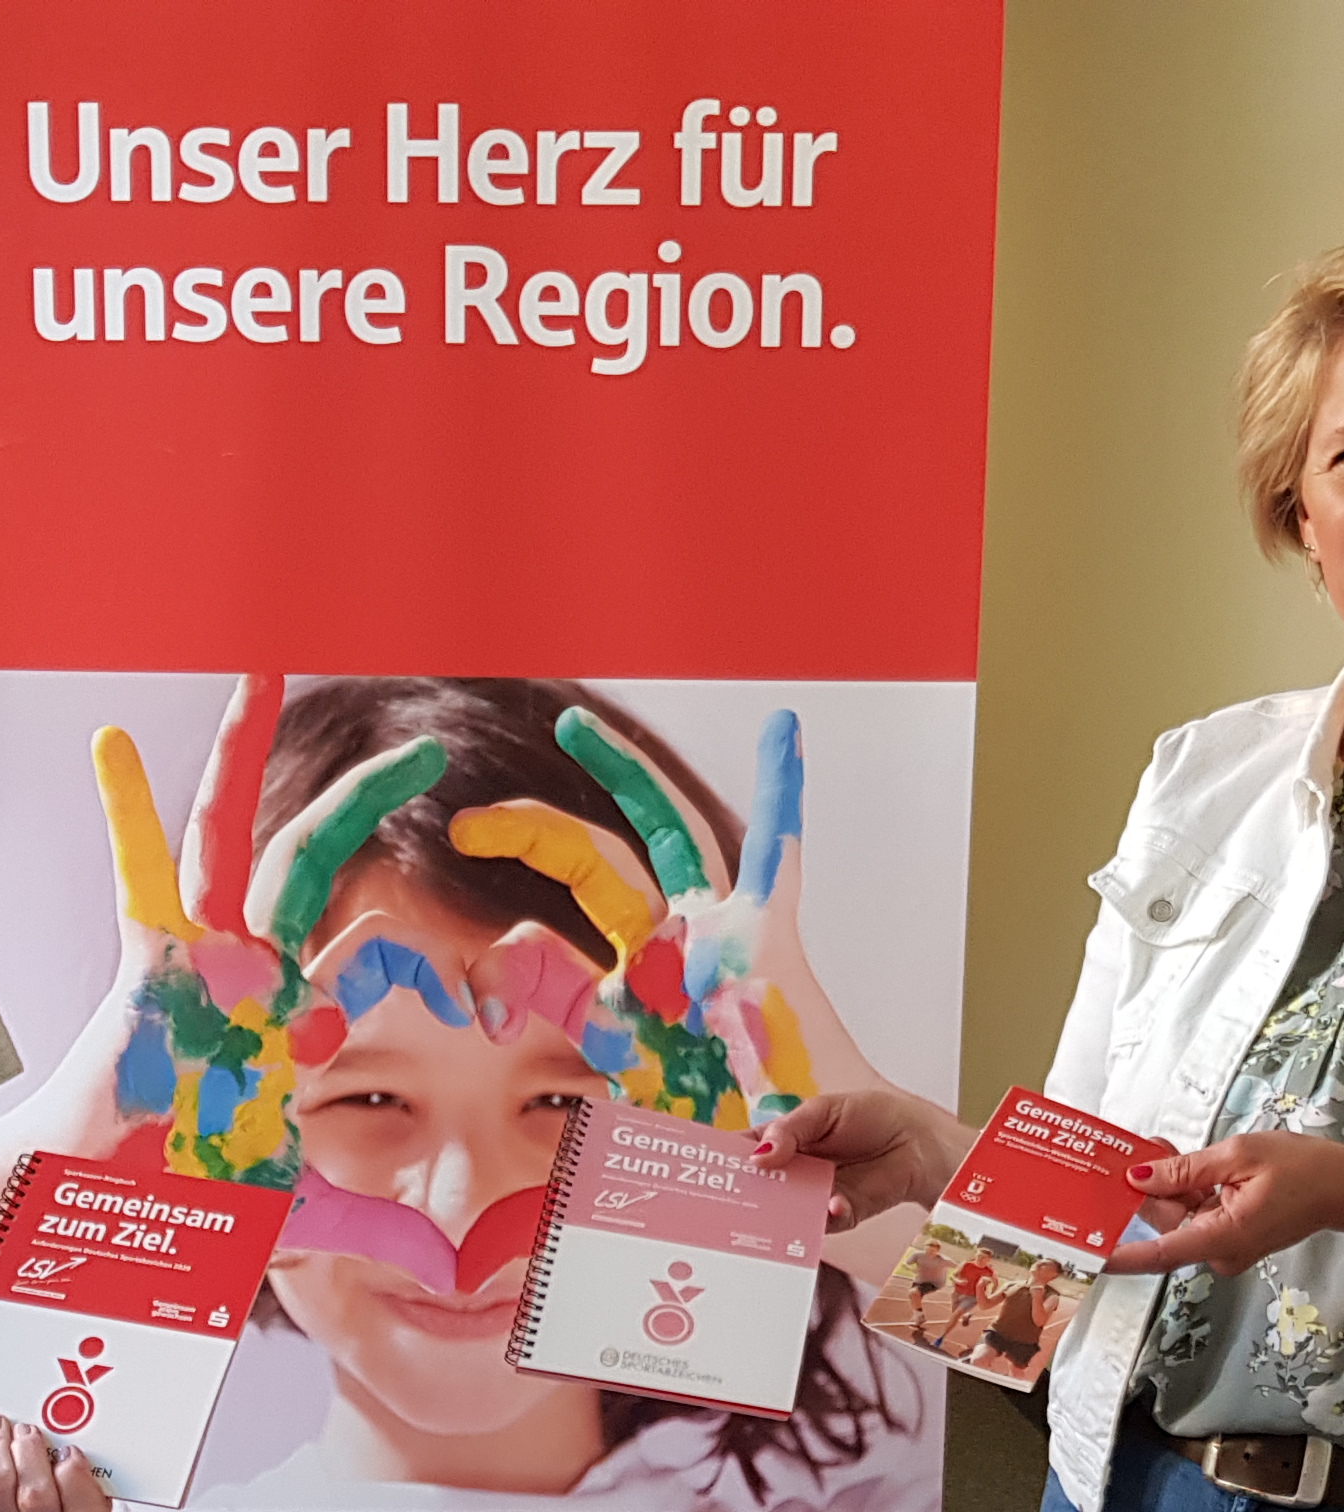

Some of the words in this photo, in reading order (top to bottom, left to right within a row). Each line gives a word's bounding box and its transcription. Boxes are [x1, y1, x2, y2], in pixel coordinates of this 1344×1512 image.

[25, 100, 351, 203] Unser
[385, 101, 642, 207] Herz
[671, 98, 838, 208] für
[31, 265, 407, 345] unsere
[442, 239, 857, 376] Region.
[1004, 1115, 1049, 1140] zum
[1052, 1130, 1096, 1157] Ziel.
[1014, 1099, 1134, 1156] Gemeinsam
[603, 1152, 670, 1179] zum
[676, 1163, 742, 1194] Ziel.
[53, 1181, 236, 1234] Gemeinsam
[37, 1213, 107, 1243] zum
[111, 1220, 178, 1255] Ziel.
[16, 1256, 79, 1281] LSV
